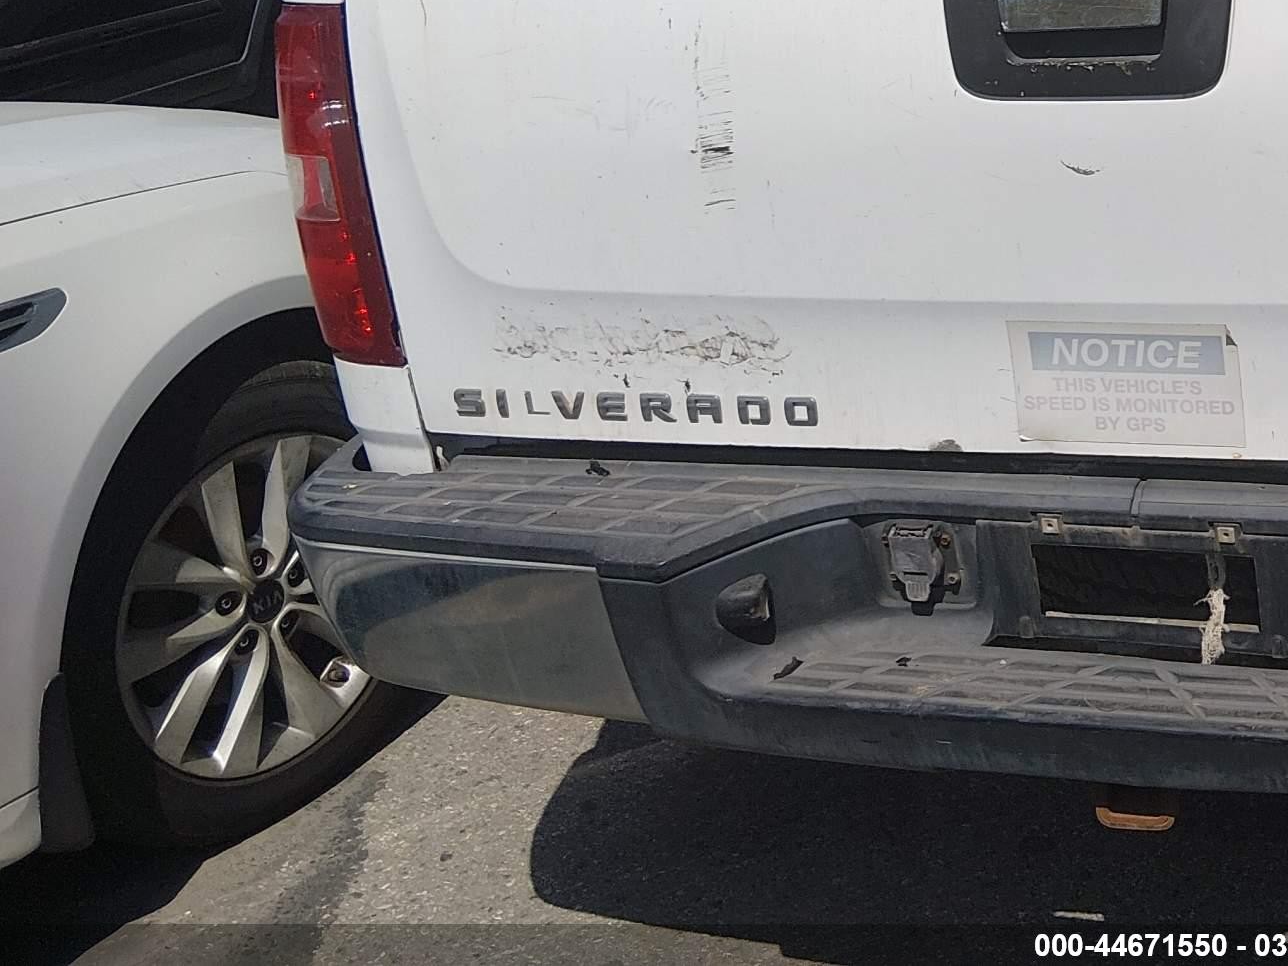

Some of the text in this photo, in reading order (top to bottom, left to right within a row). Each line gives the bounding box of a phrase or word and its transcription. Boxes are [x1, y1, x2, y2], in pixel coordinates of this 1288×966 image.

[1051, 337, 1203, 369] NOTICE
[1052, 376, 1203, 395] THIS VEHICLE'S
[453, 387, 819, 427] SILVERADO
[1024, 395, 1236, 415] SPEED IS MONITORED
[1095, 416, 1167, 433] BY GPS
